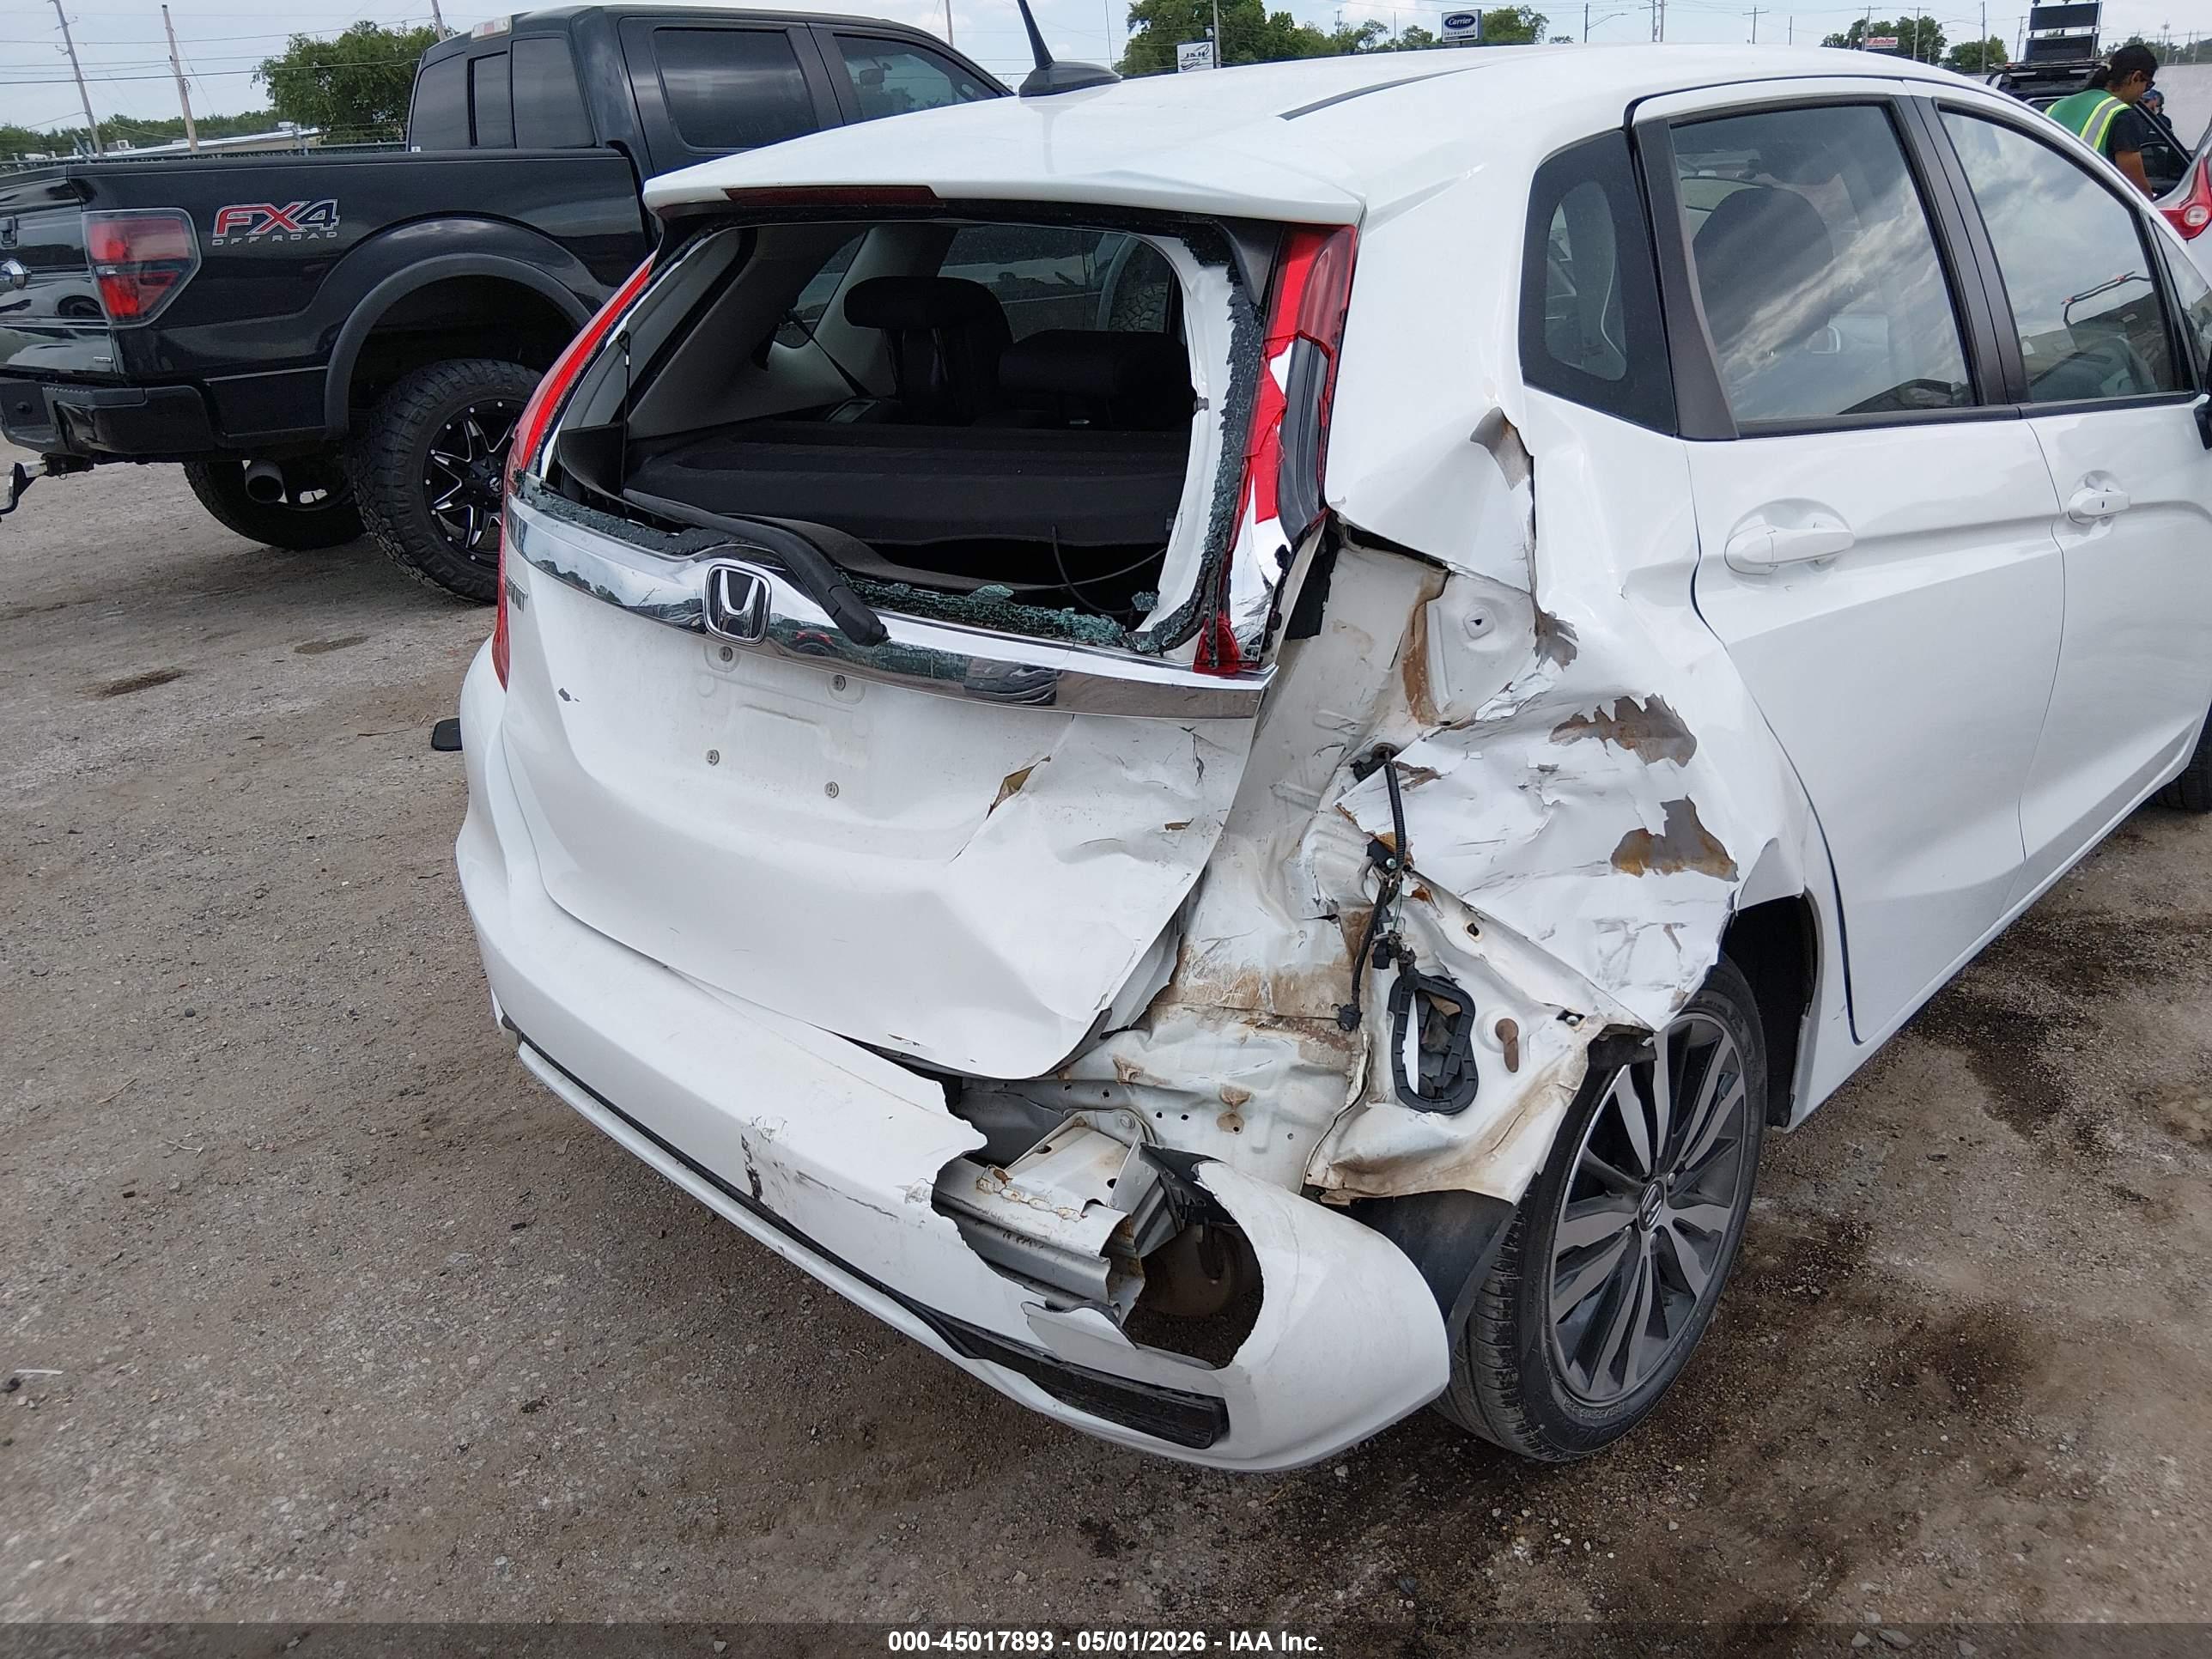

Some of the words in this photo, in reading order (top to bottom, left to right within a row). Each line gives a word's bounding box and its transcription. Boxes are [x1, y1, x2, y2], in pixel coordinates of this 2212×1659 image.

[1448, 16, 1473, 27] Carrier
[212, 199, 340, 238] FX4
[211, 236, 260, 246] OFF
[271, 231, 337, 242] ROAD
